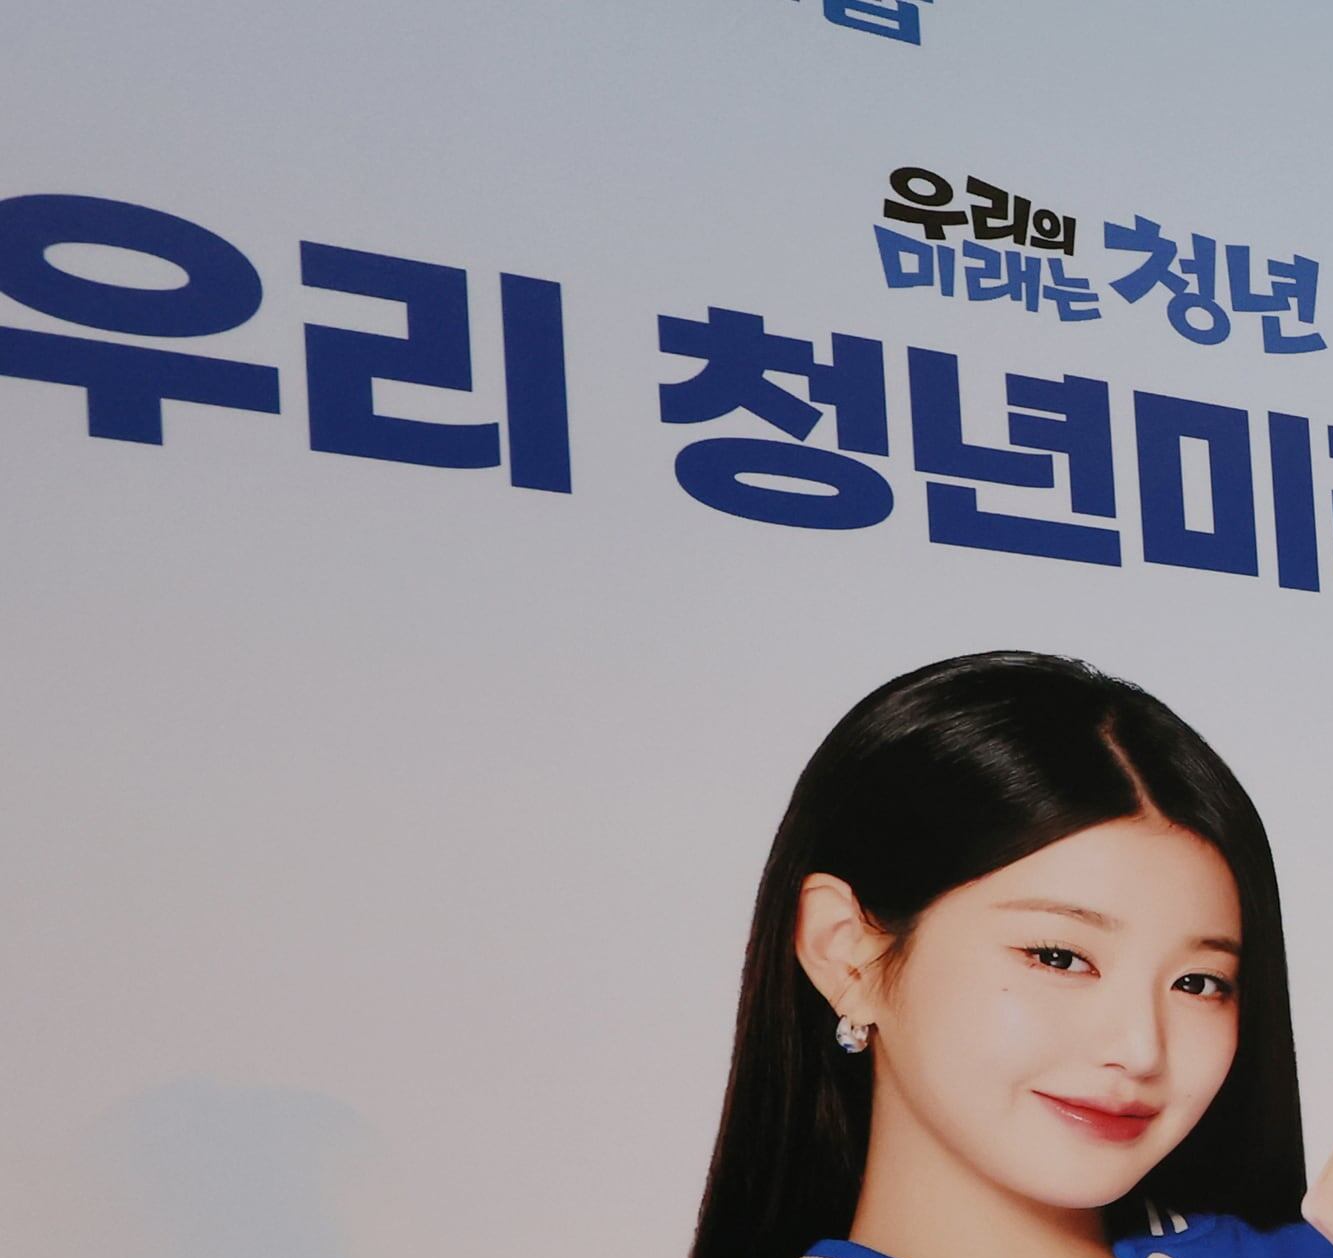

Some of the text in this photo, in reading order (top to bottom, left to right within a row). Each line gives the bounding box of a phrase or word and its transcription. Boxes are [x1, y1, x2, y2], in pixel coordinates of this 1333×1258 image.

[884, 167, 1076, 256] 우리의
[0, 194, 571, 494] 우리
[874, 214, 1327, 354] 미래는 청년
